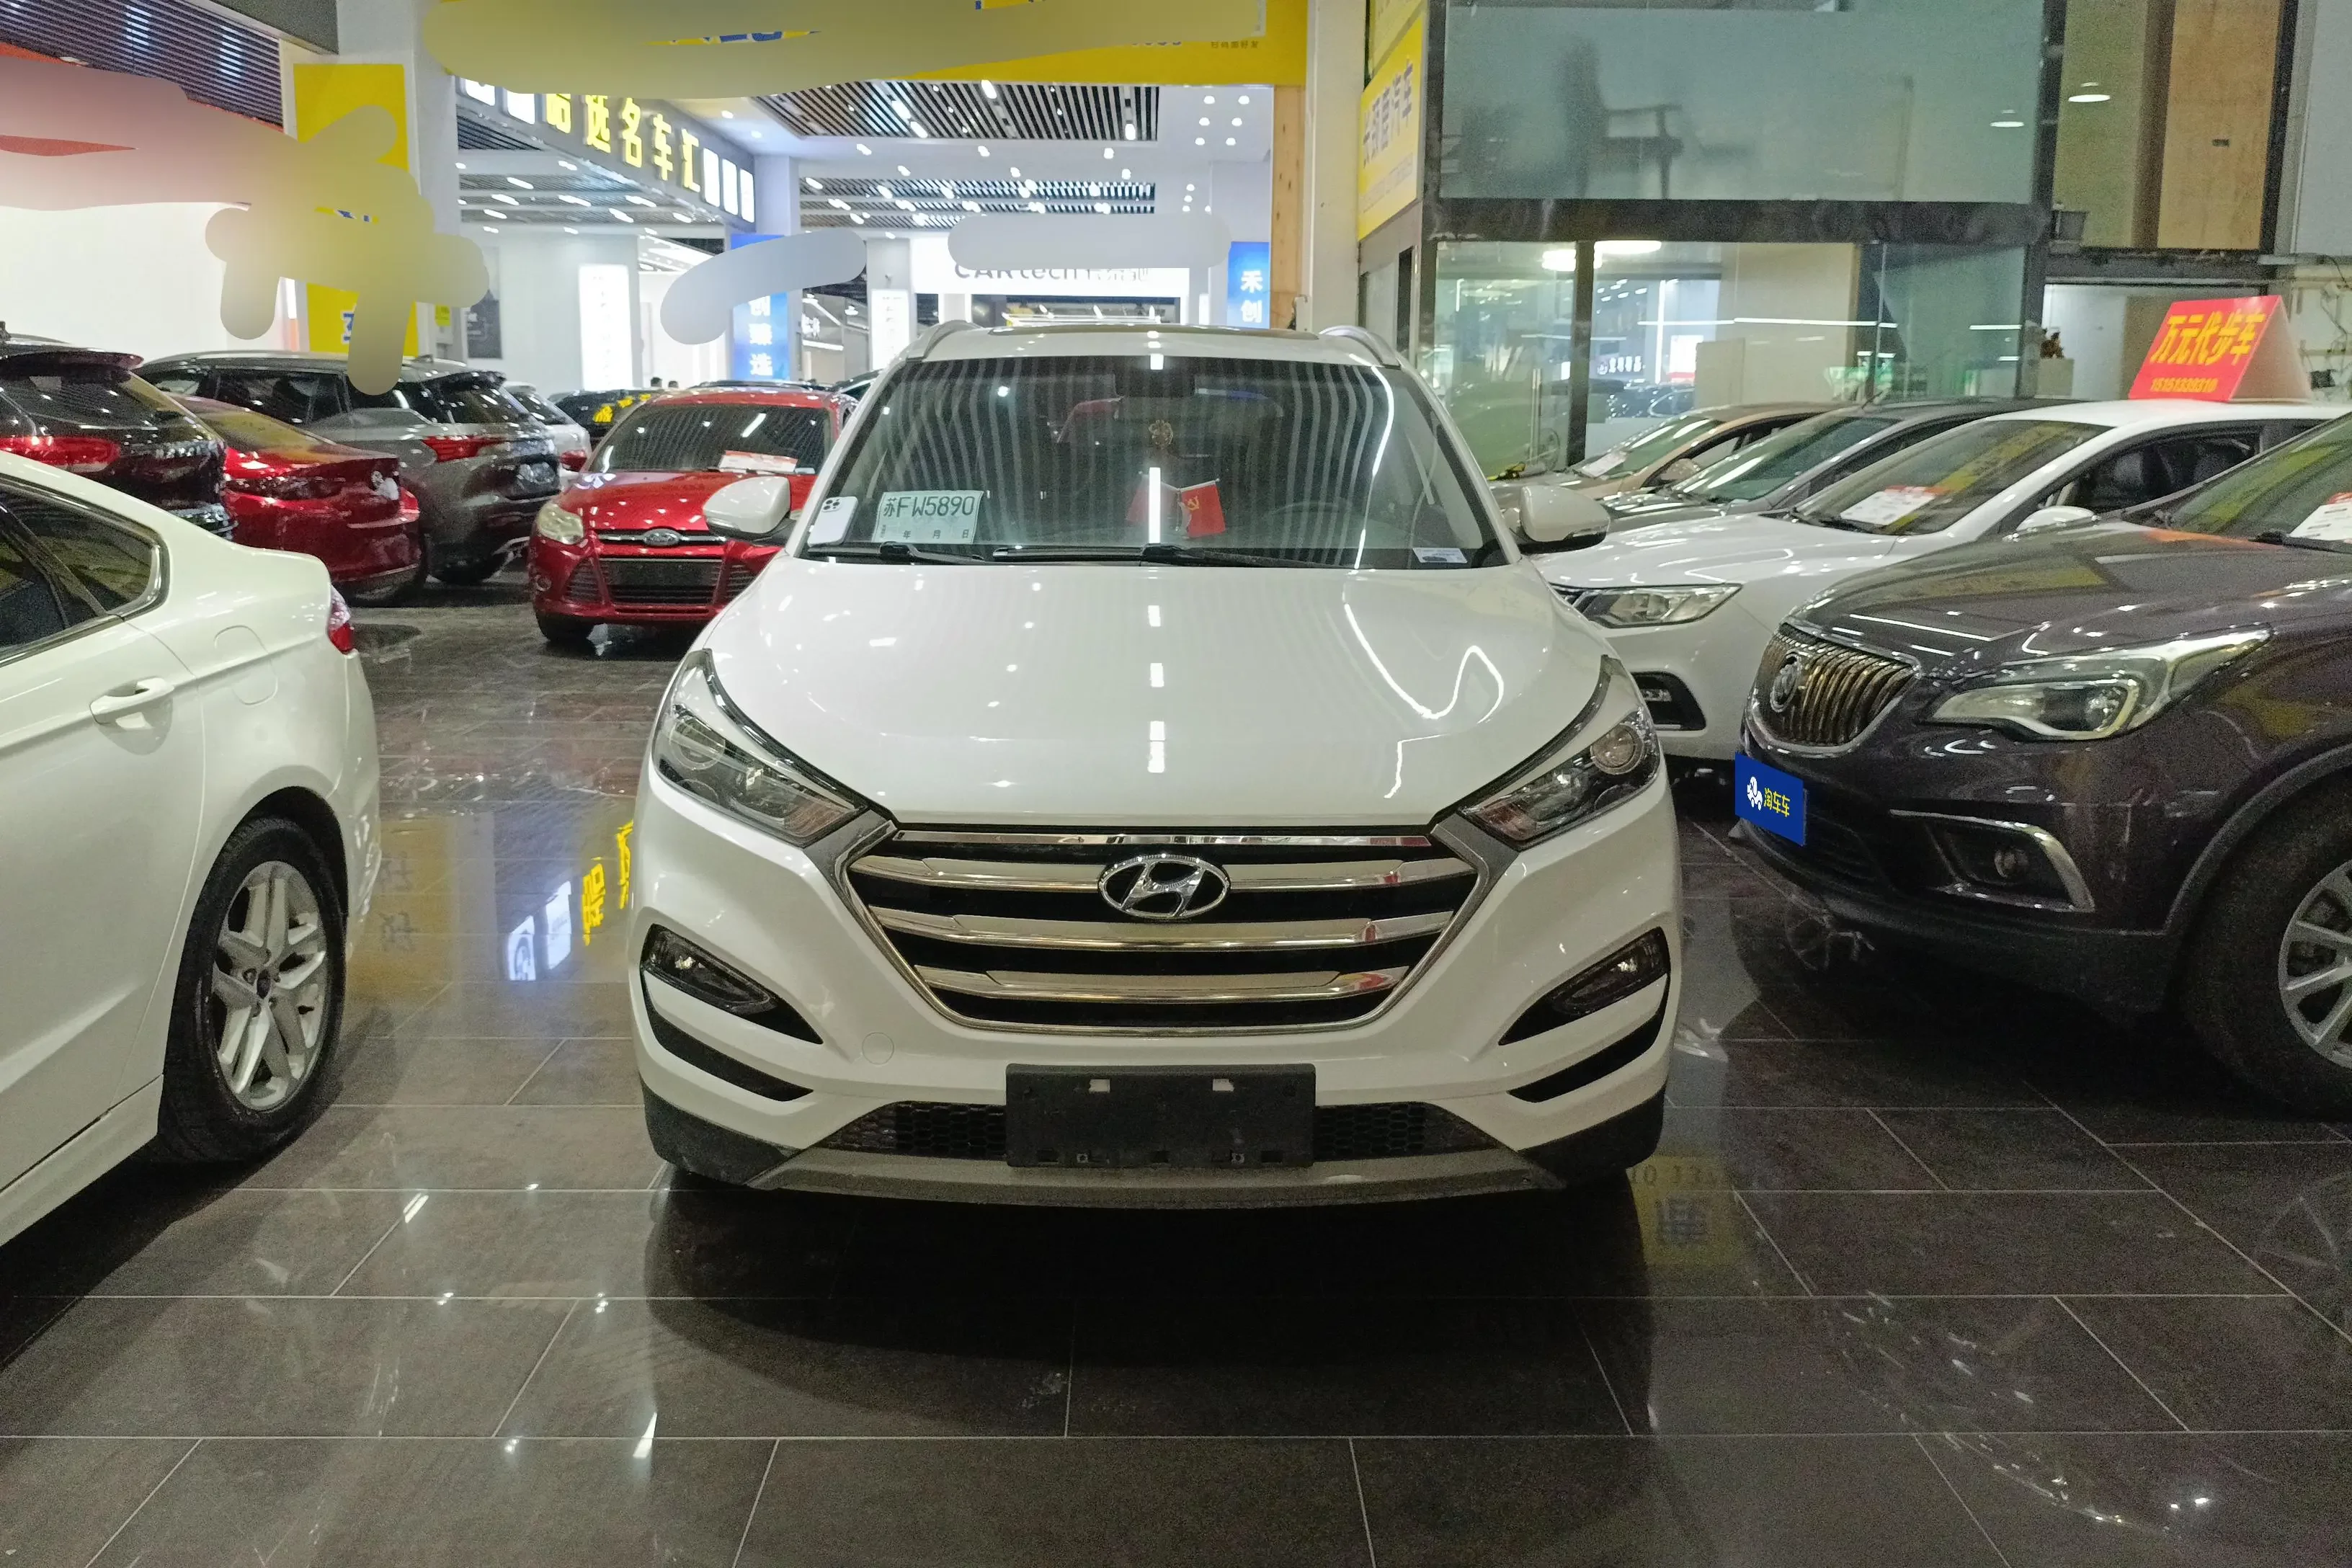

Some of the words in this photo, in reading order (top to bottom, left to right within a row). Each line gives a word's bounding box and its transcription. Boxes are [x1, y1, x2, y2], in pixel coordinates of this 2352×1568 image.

[2150, 308, 2266, 366] 万元代步车
